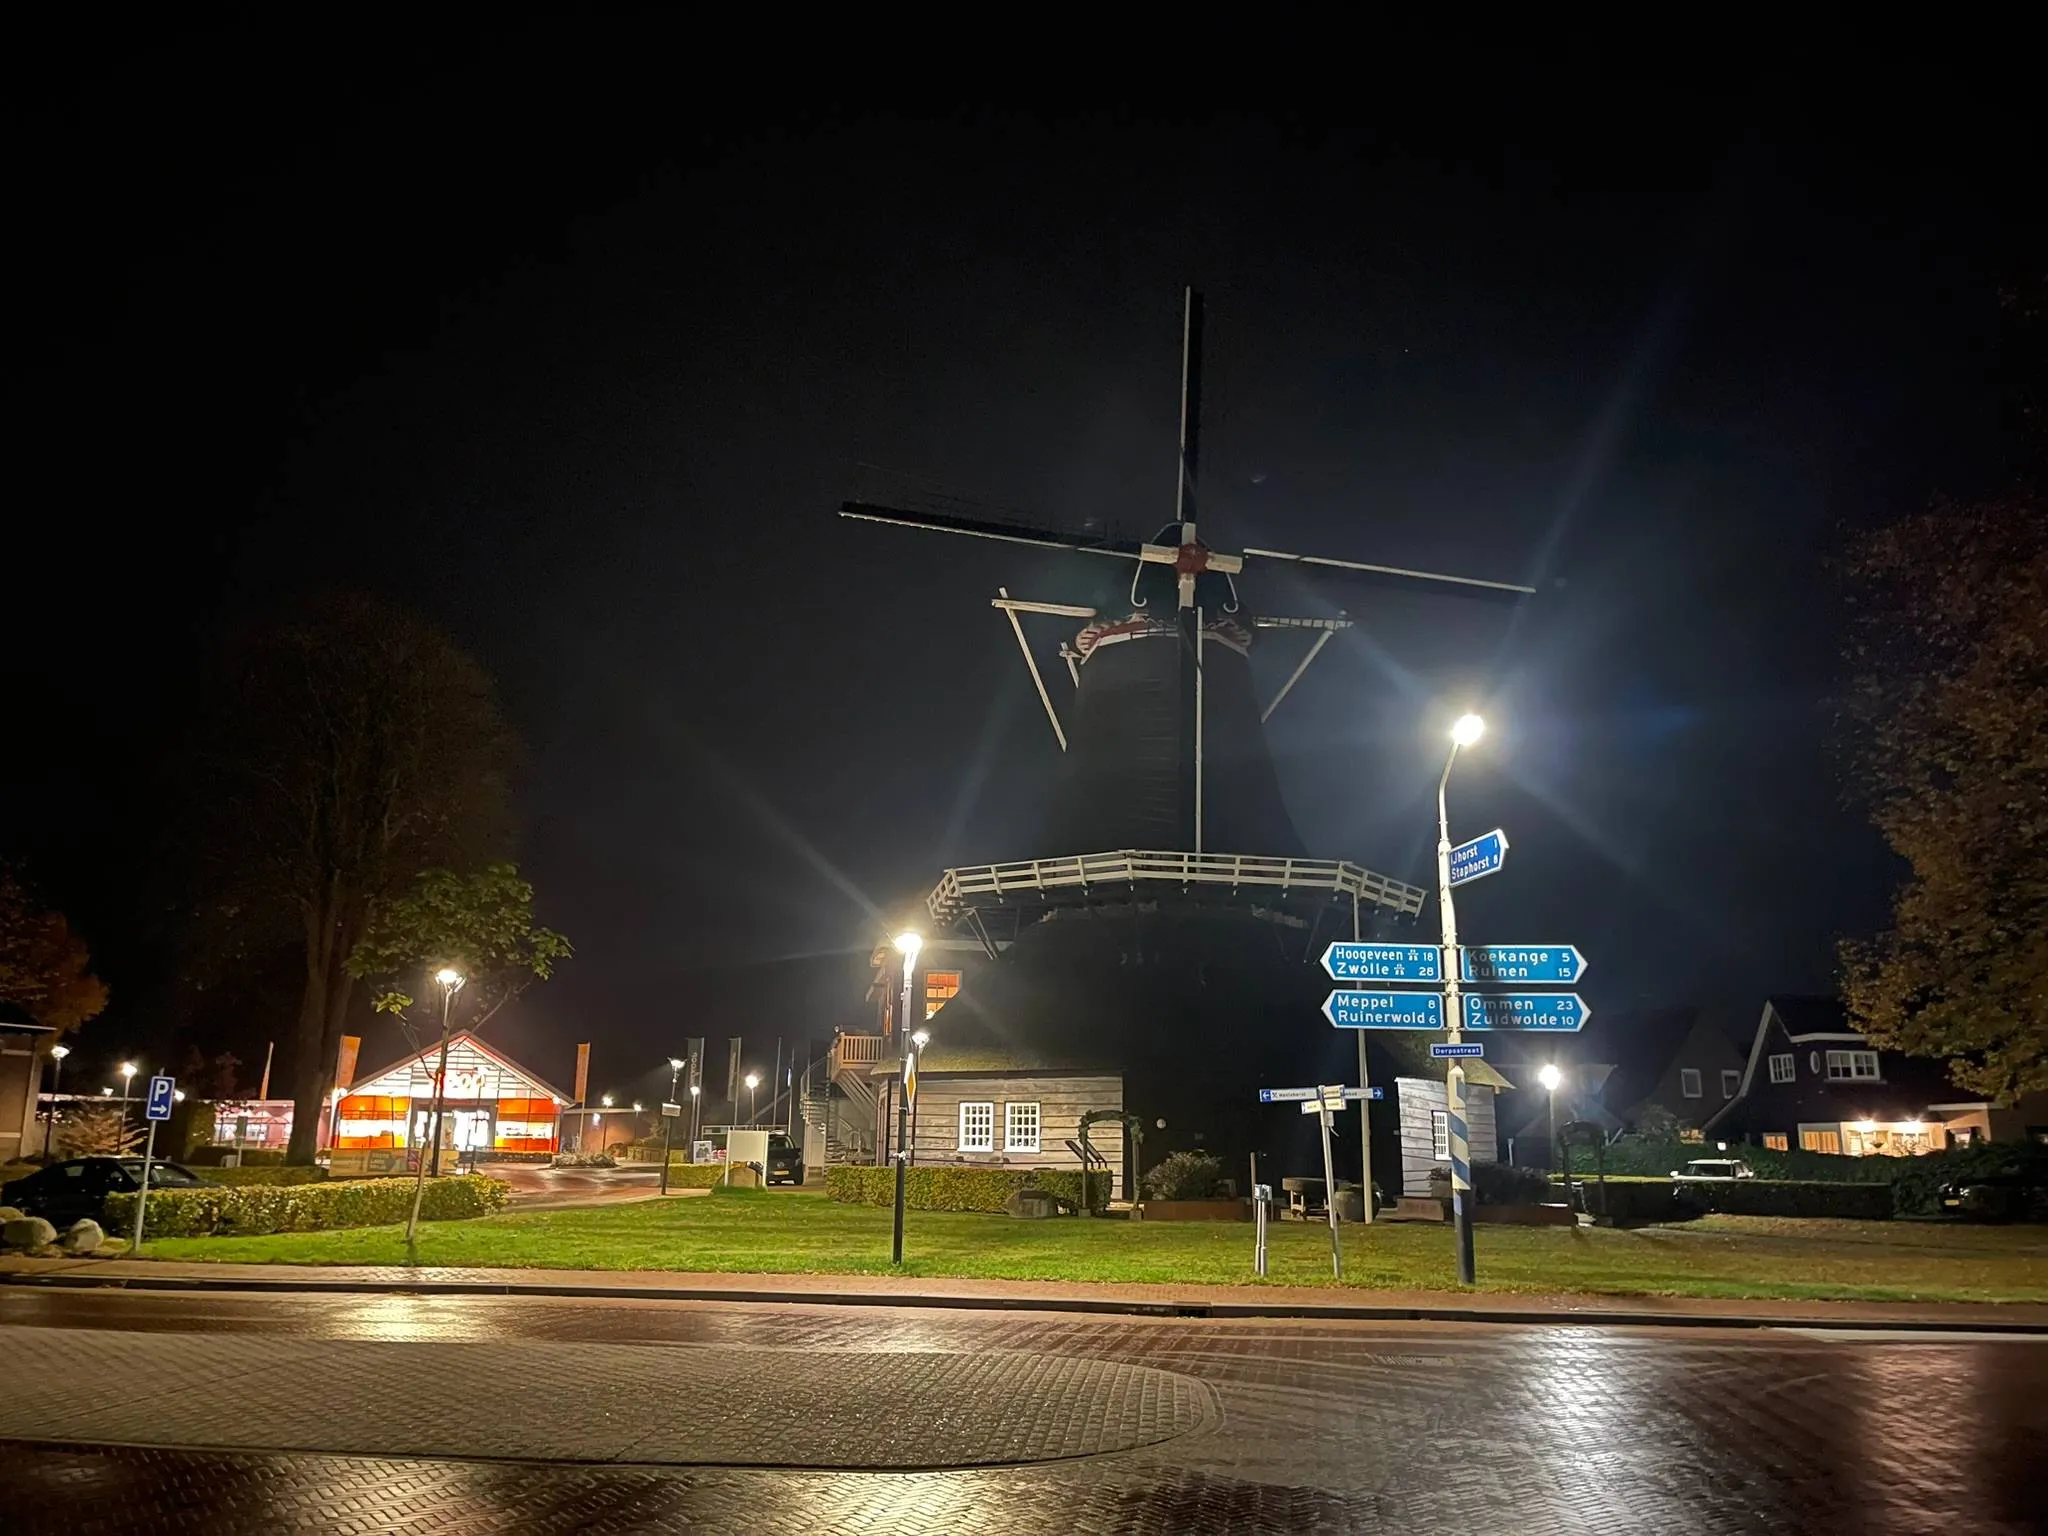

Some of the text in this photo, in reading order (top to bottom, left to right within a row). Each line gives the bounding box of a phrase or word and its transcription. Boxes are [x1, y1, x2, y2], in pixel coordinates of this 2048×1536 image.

[1450, 844, 1478, 864] IJhorst
[1451, 854, 1499, 880] Staphorst 8
[1335, 946, 1434, 963] Hoogeveen 18
[1468, 950, 1571, 966] Koekange 5
[1336, 962, 1434, 977] Zwolle 28
[1468, 965, 1572, 978] Ruinen 15
[1337, 994, 1436, 1010] Meppel 8
[1470, 997, 1574, 1011] Ommen 23
[1338, 1009, 1437, 1025] Ruinerwold 6
[1471, 1012, 1575, 1026] Zuidwolde 10
[154, 1080, 170, 1102] P
